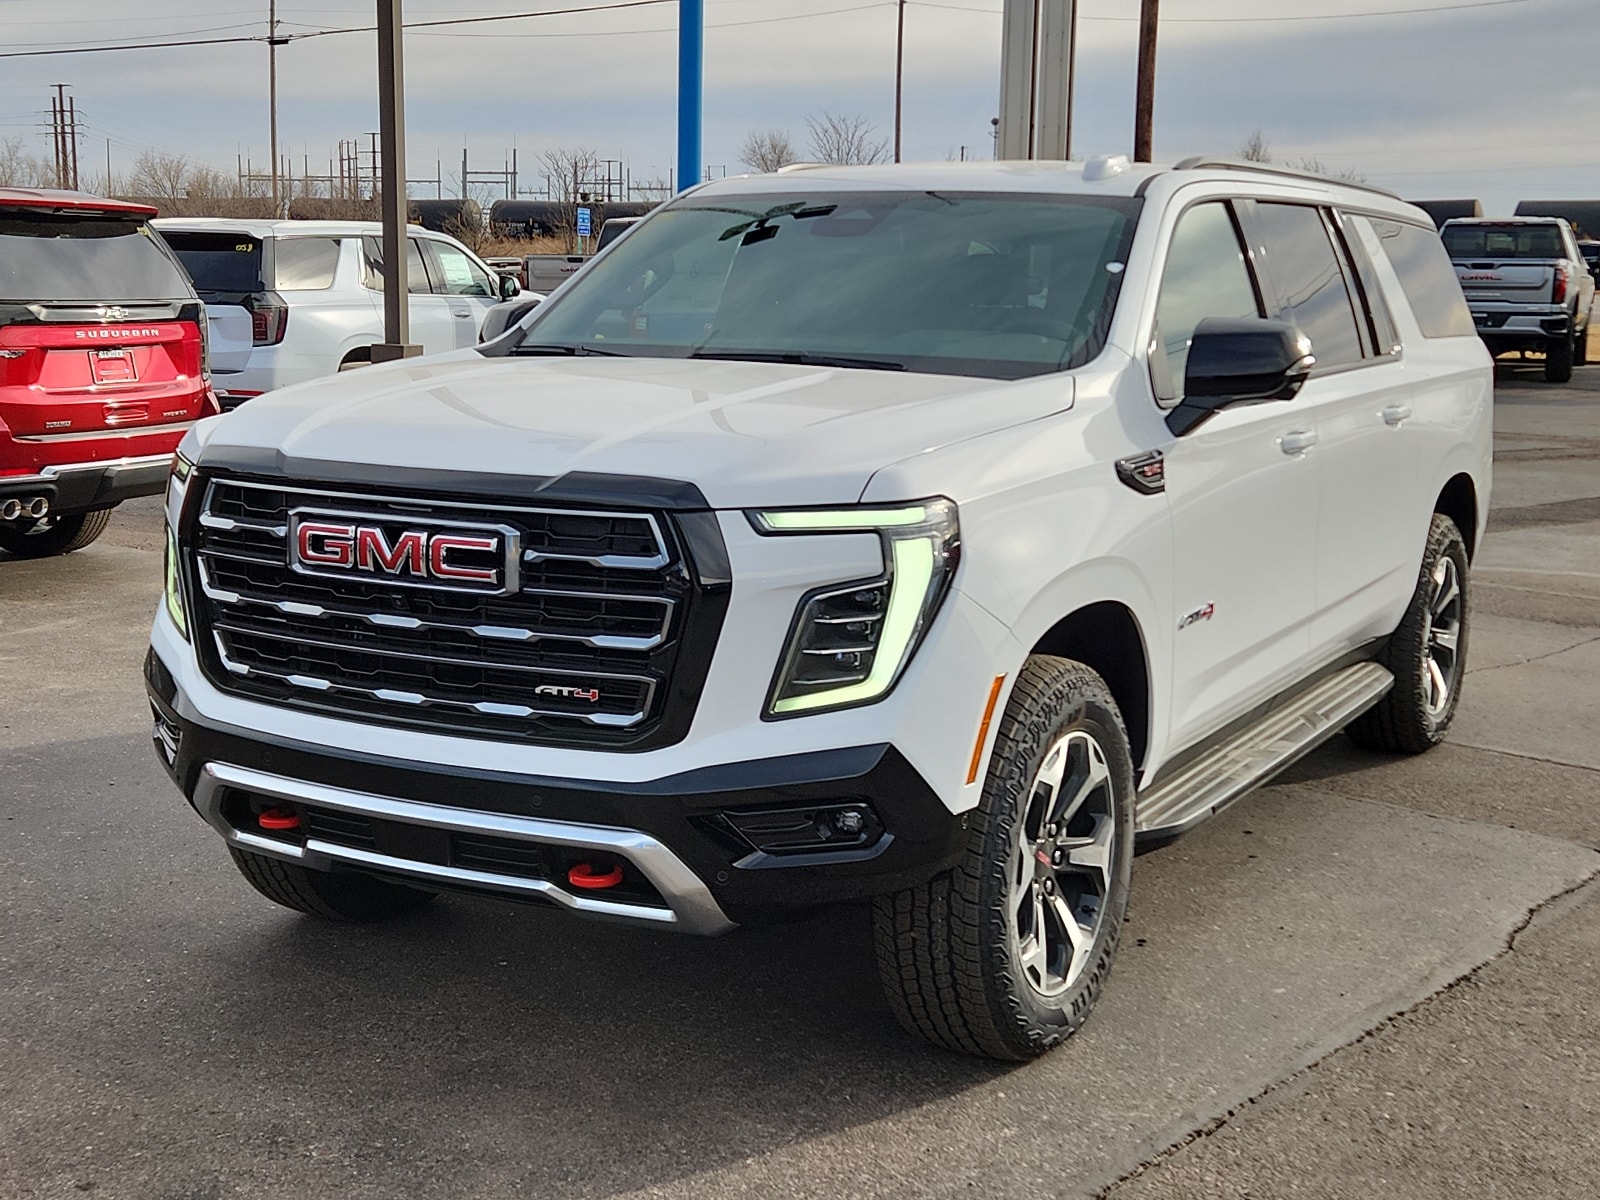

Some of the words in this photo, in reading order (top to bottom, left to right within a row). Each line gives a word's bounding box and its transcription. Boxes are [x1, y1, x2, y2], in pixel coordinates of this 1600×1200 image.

[75, 328, 160, 339] SUBURBAN
[297, 521, 498, 585] GMC
[534, 685, 599, 703] AT4
